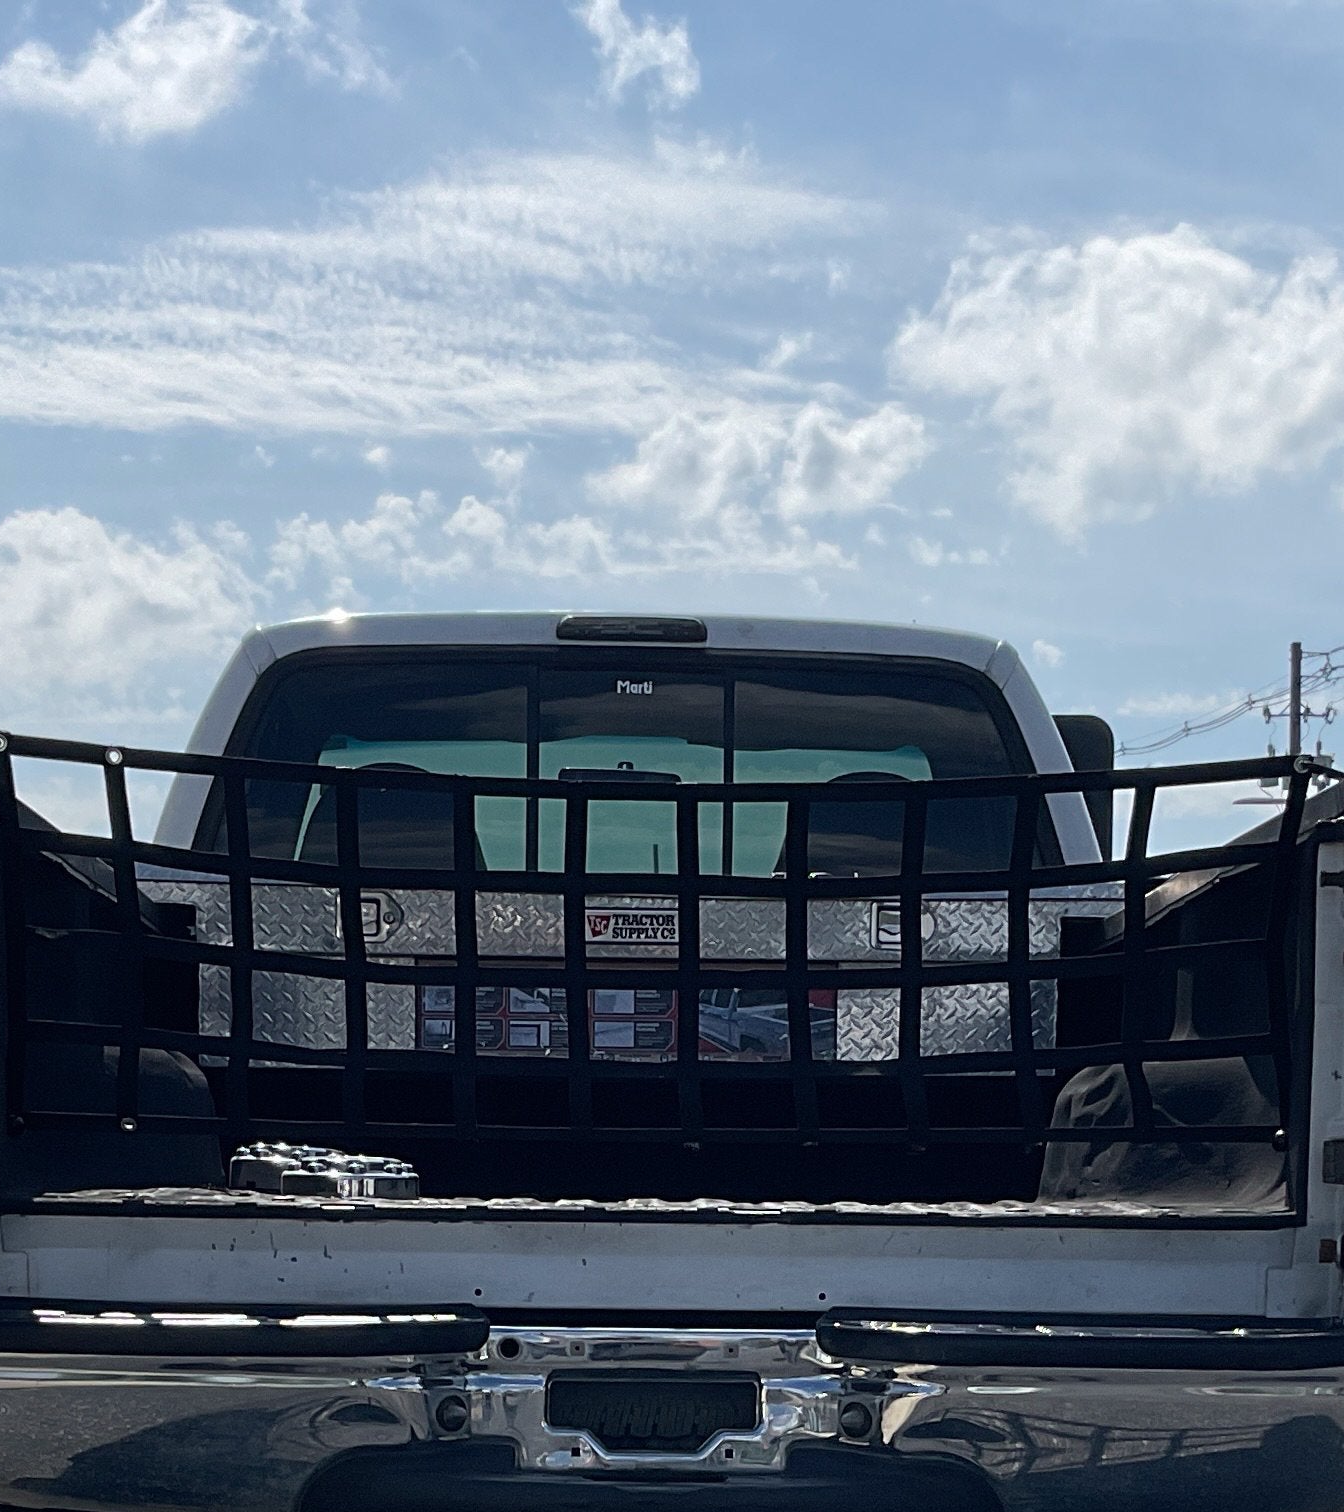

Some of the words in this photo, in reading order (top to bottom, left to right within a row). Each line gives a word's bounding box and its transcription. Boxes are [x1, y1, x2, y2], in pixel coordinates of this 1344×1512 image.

[617, 680, 653, 694] Marti
[588, 916, 608, 934] TSC
[612, 914, 676, 926] TRACTOR
[612, 927, 660, 939] SUPPLY
